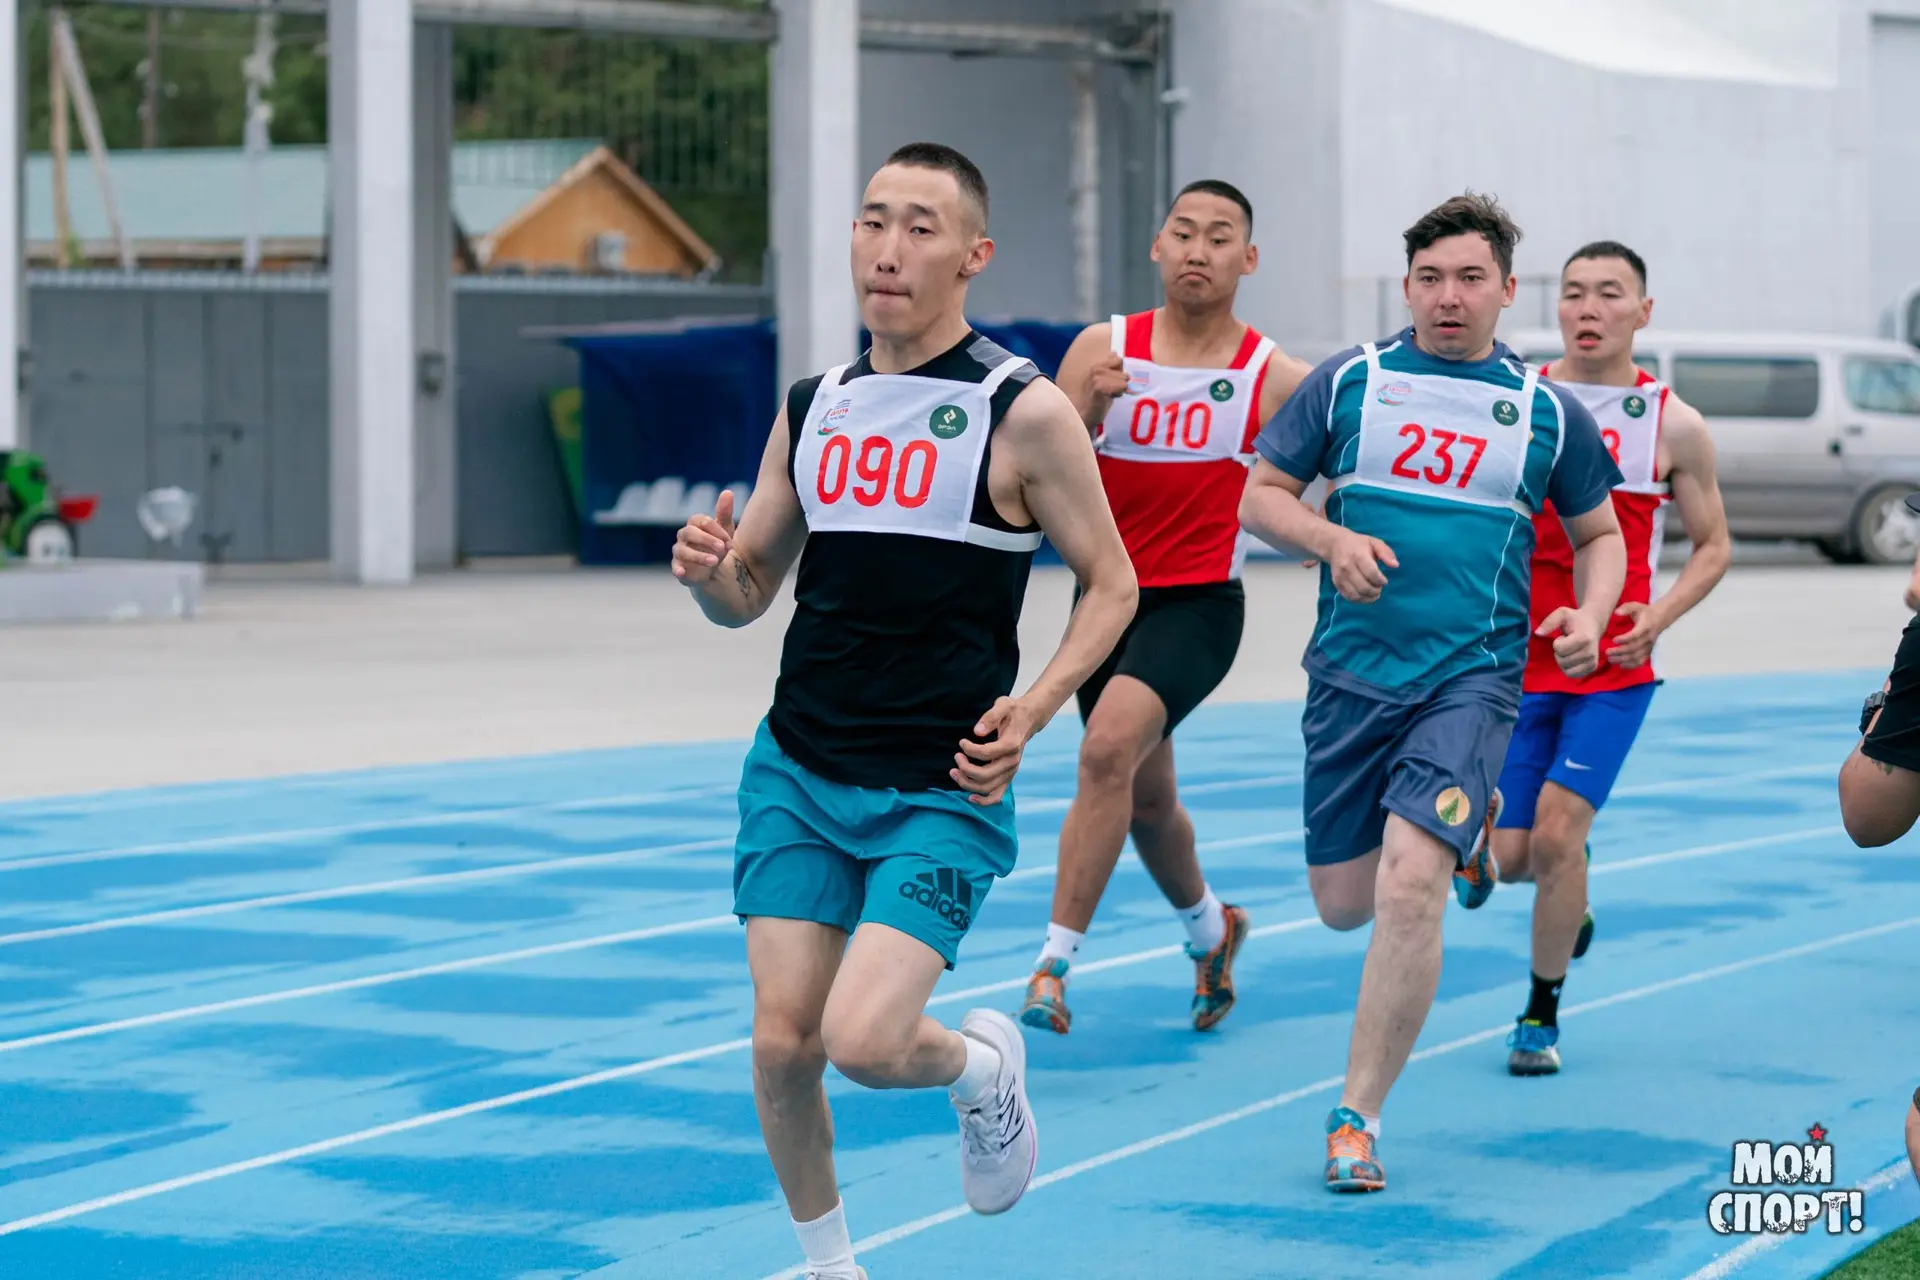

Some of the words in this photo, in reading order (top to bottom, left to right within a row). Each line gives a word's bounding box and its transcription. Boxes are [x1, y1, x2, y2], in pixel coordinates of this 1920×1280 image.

[1130, 397, 1212, 450] 010
[816, 434, 938, 509] 090
[1391, 423, 1487, 489] 237
[899, 881, 971, 931] adidas
